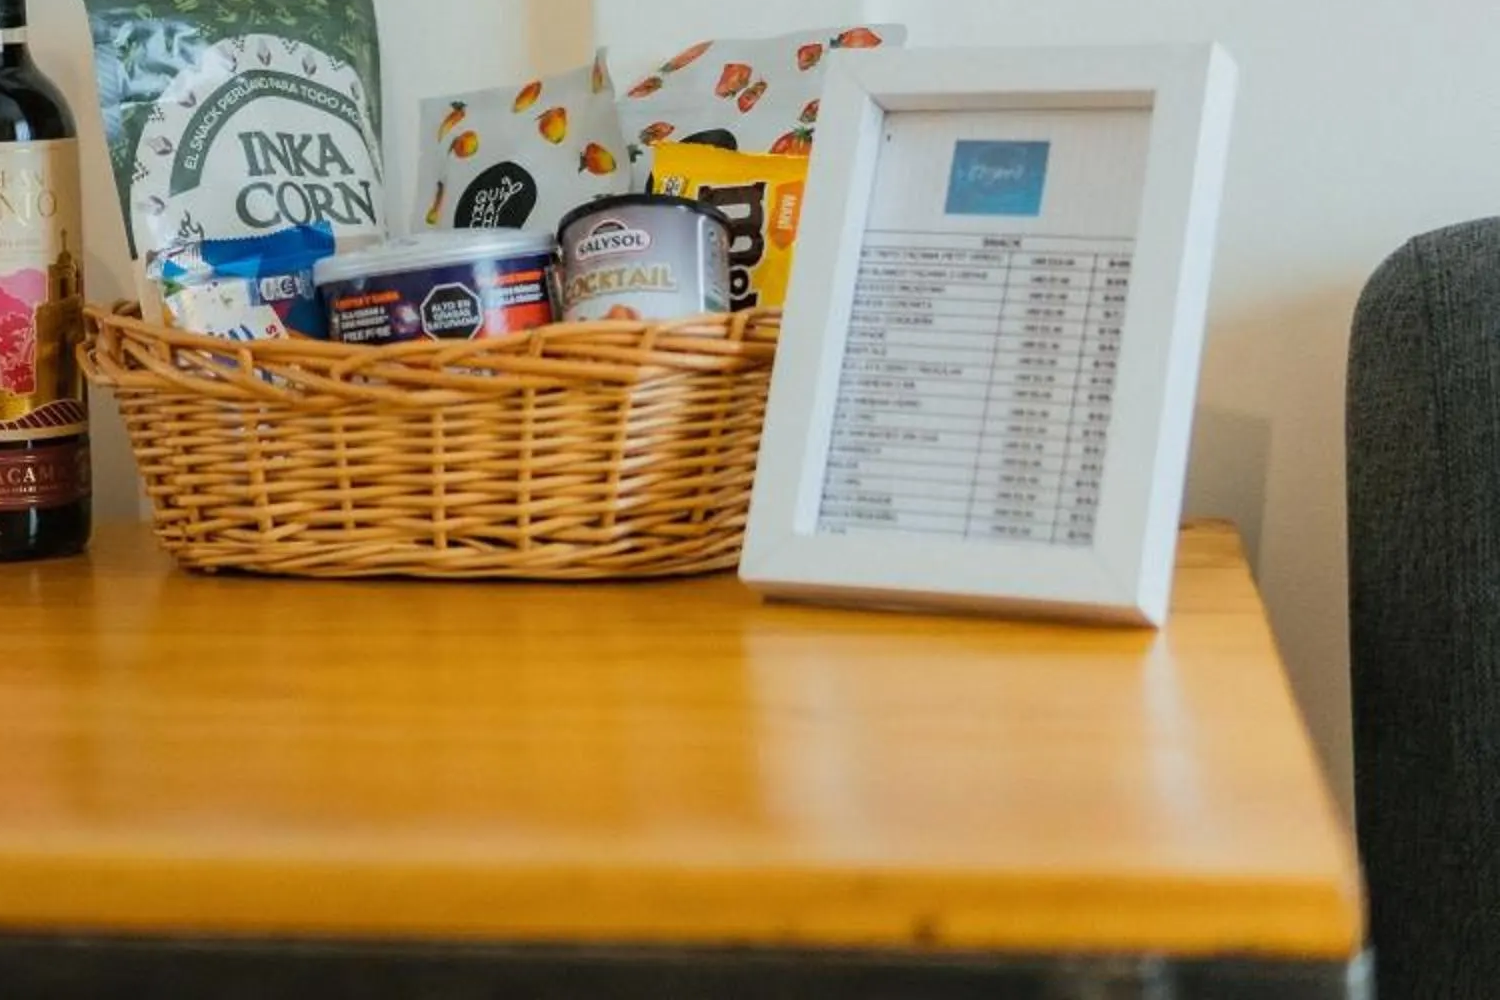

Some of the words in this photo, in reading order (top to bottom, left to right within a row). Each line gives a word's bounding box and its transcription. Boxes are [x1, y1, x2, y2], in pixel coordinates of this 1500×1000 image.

[188, 107, 223, 150] SNACK
[238, 131, 355, 177] INKA
[235, 181, 377, 230] CORN
[579, 232, 646, 255] SALYSOL
